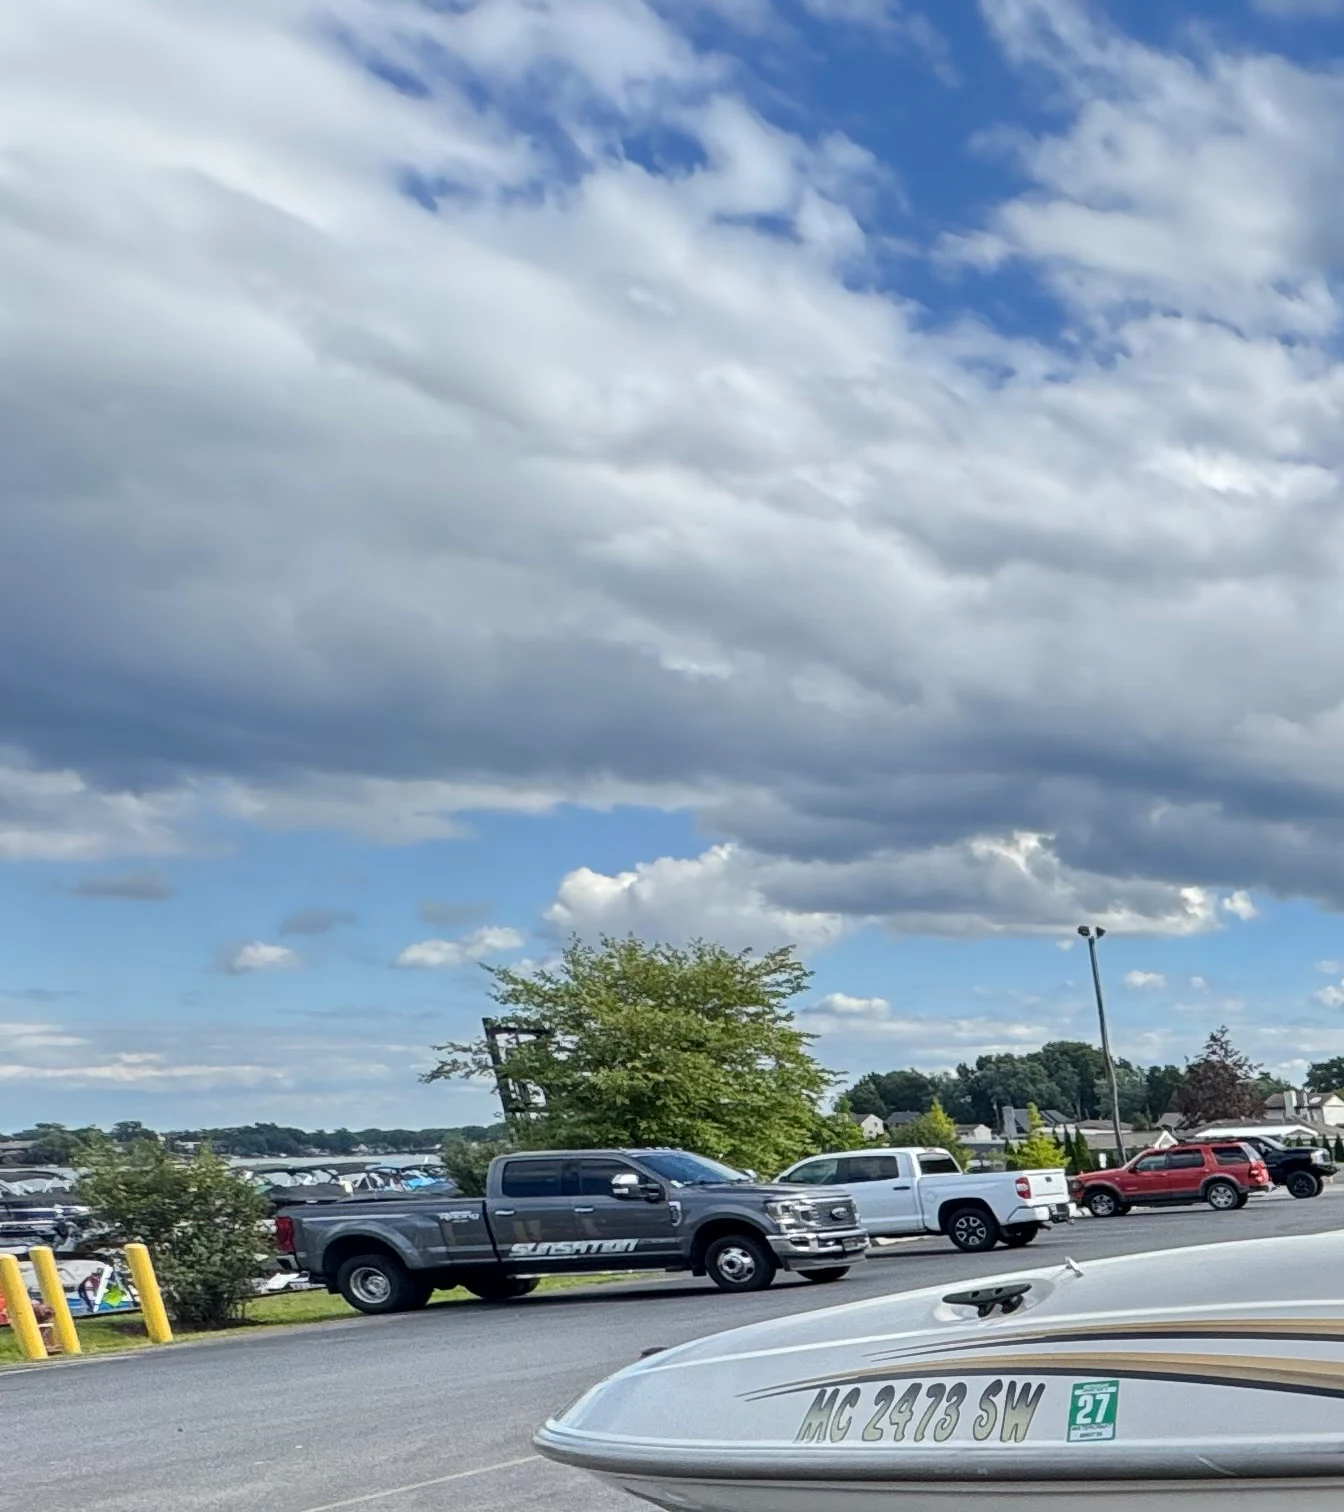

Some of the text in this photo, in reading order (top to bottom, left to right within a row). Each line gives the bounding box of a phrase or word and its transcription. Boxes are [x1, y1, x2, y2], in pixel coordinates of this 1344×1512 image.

[793, 1379, 1046, 1443] MC 2473 SW
[1076, 1394, 1110, 1424] 27
